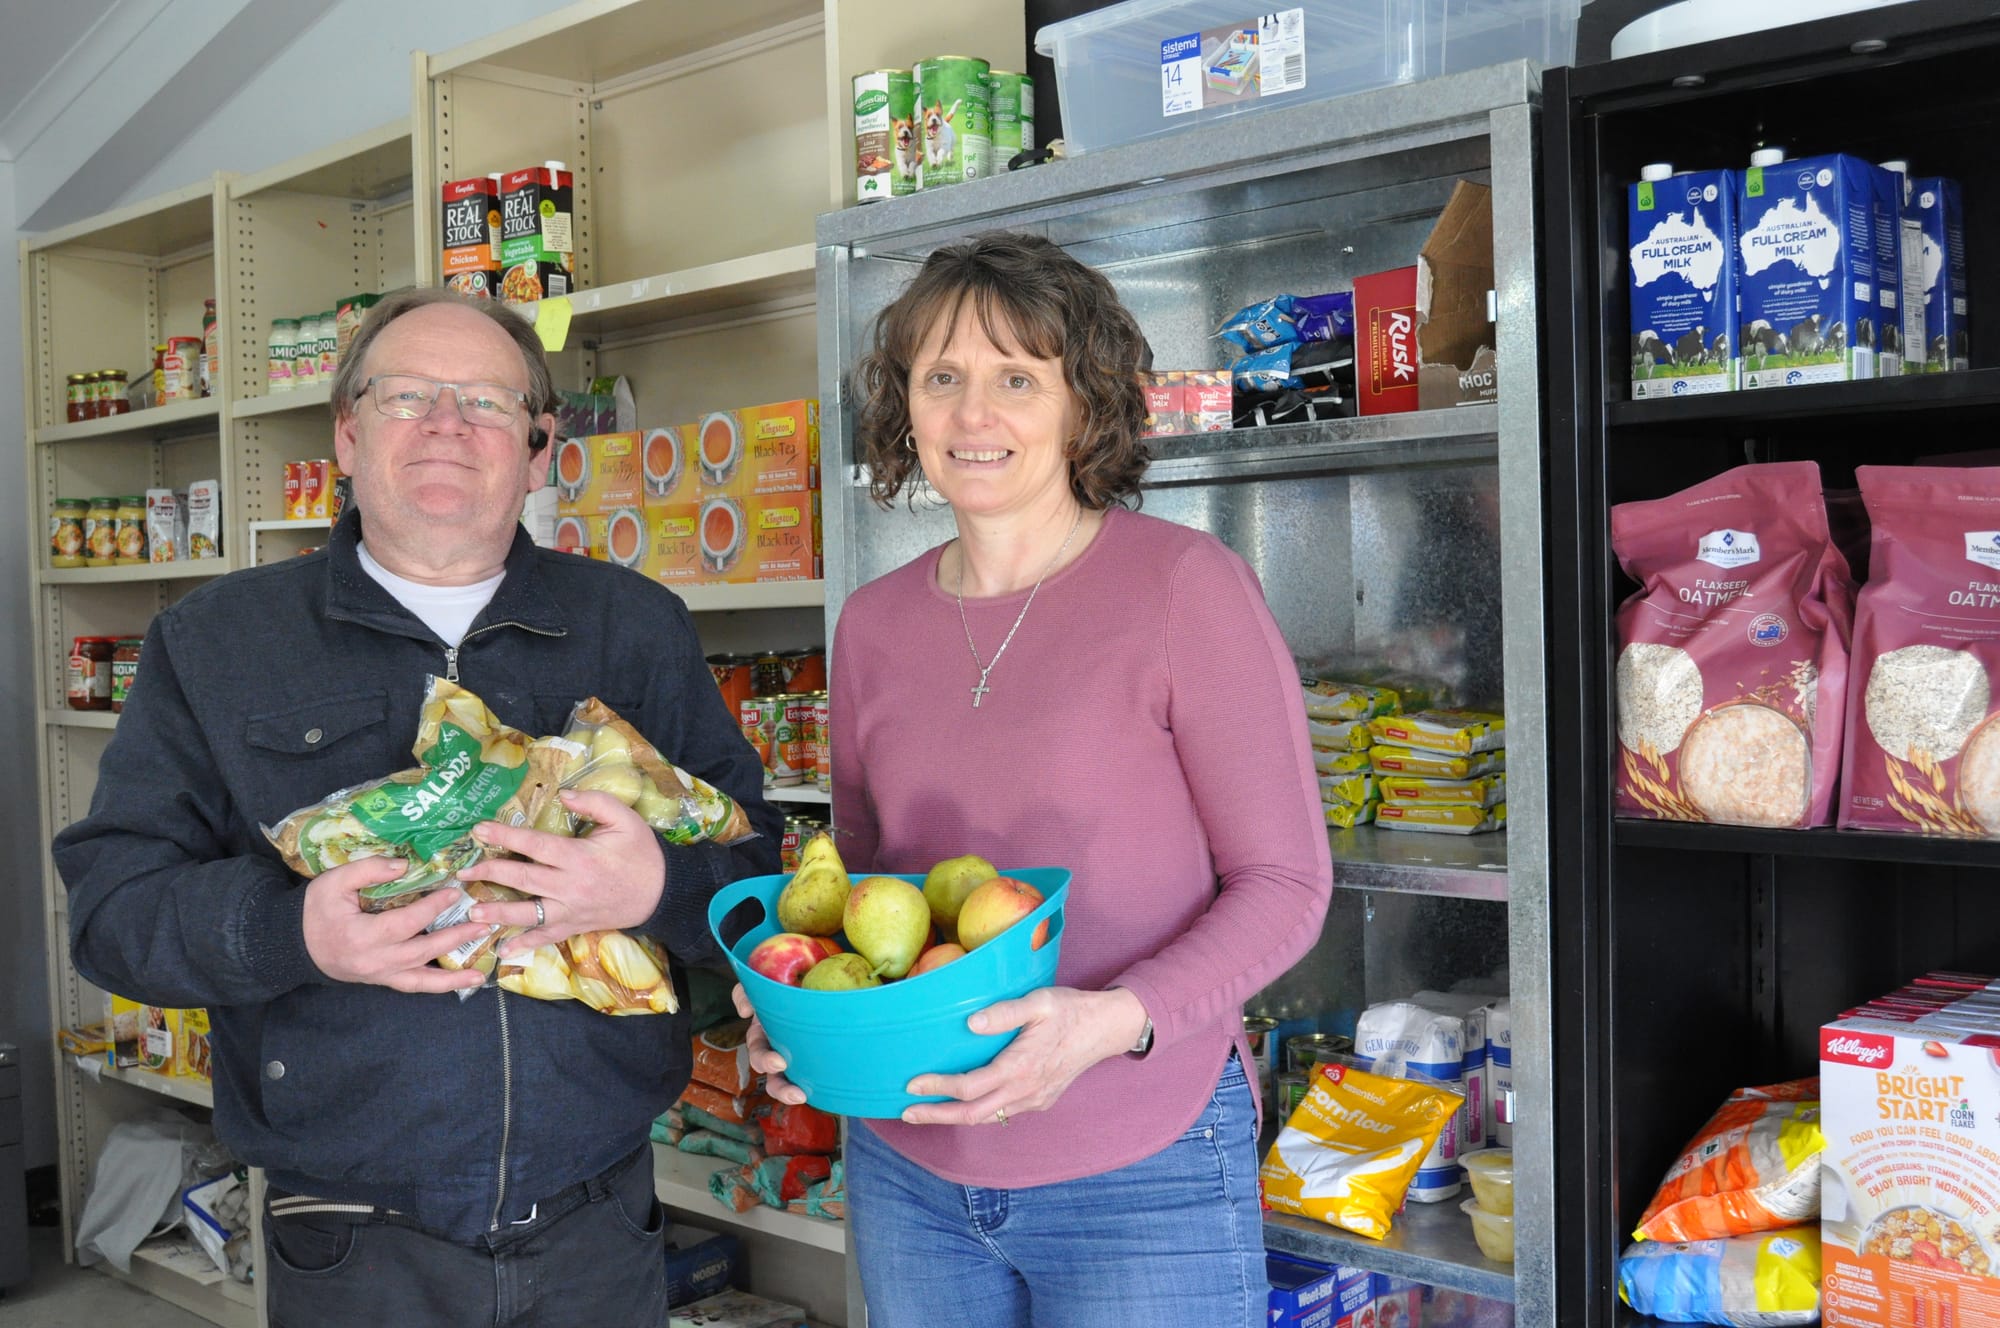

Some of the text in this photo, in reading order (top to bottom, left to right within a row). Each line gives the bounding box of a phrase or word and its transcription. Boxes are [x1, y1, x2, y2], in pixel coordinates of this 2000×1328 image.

[1164, 64, 1182, 88] 14
[446, 205, 482, 228] REAL
[505, 196, 535, 219] REAL
[446, 224, 482, 243] STOCK
[504, 214, 536, 234] STOCK
[1766, 221, 1812, 232] AUSTRALIAN
[1656, 234, 1699, 245] AUSTRALIAN
[1752, 228, 1828, 248] FULL CREAM
[450, 255, 478, 264] Chicken
[504, 244, 535, 258] Vegetable
[1642, 242, 1712, 260] FULL CREAM
[1774, 244, 1805, 256] MILK
[1663, 257, 1692, 270] MILK
[1388, 312, 1415, 381] Rusk
[1150, 392, 1170, 400] Trail
[1152, 400, 1168, 408] Mix
[761, 423, 790, 436] Kingston
[754, 442, 796, 459] Black Tea
[764, 513, 794, 526] Kingston
[756, 532, 800, 548] Black Tea
[1696, 578, 1748, 591] FLAXSEED
[401, 750, 472, 822] SALADS
[437, 764, 499, 829] ABY WHITE
[1365, 1038, 1384, 1053] GEM
[1826, 1036, 1886, 1063] Kellogg's
[1342, 1082, 1386, 1106] essentials
[1876, 1071, 1966, 1100] BRIGHT
[1300, 1100, 1342, 1130] luten free
[1308, 1085, 1398, 1134] cornflour
[1876, 1098, 1949, 1123] START
[1950, 1109, 1974, 1120] CORN
[1951, 1119, 1976, 1129] FLAKES
[1850, 1130, 1874, 1146] FOOD
[1876, 1126, 1894, 1138] YOU
[1896, 1126, 1916, 1136] CAN
[1920, 1126, 1942, 1140] FEEL
[1945, 1132, 1974, 1150] GOOD
[1867, 1178, 1894, 1198] ENJOY
[1896, 1176, 1932, 1187] BRIGHT
[1935, 1180, 1990, 1218] MORNINGS!
[692, 1260, 728, 1283] NOBBY'S
[1298, 1274, 1336, 1308] Weet-Bix
[1340, 1278, 1370, 1302] OVERNIGHT
[1342, 1291, 1369, 1313] WEET-BIX
[1301, 1303, 1332, 1328] OVERNIGHT
